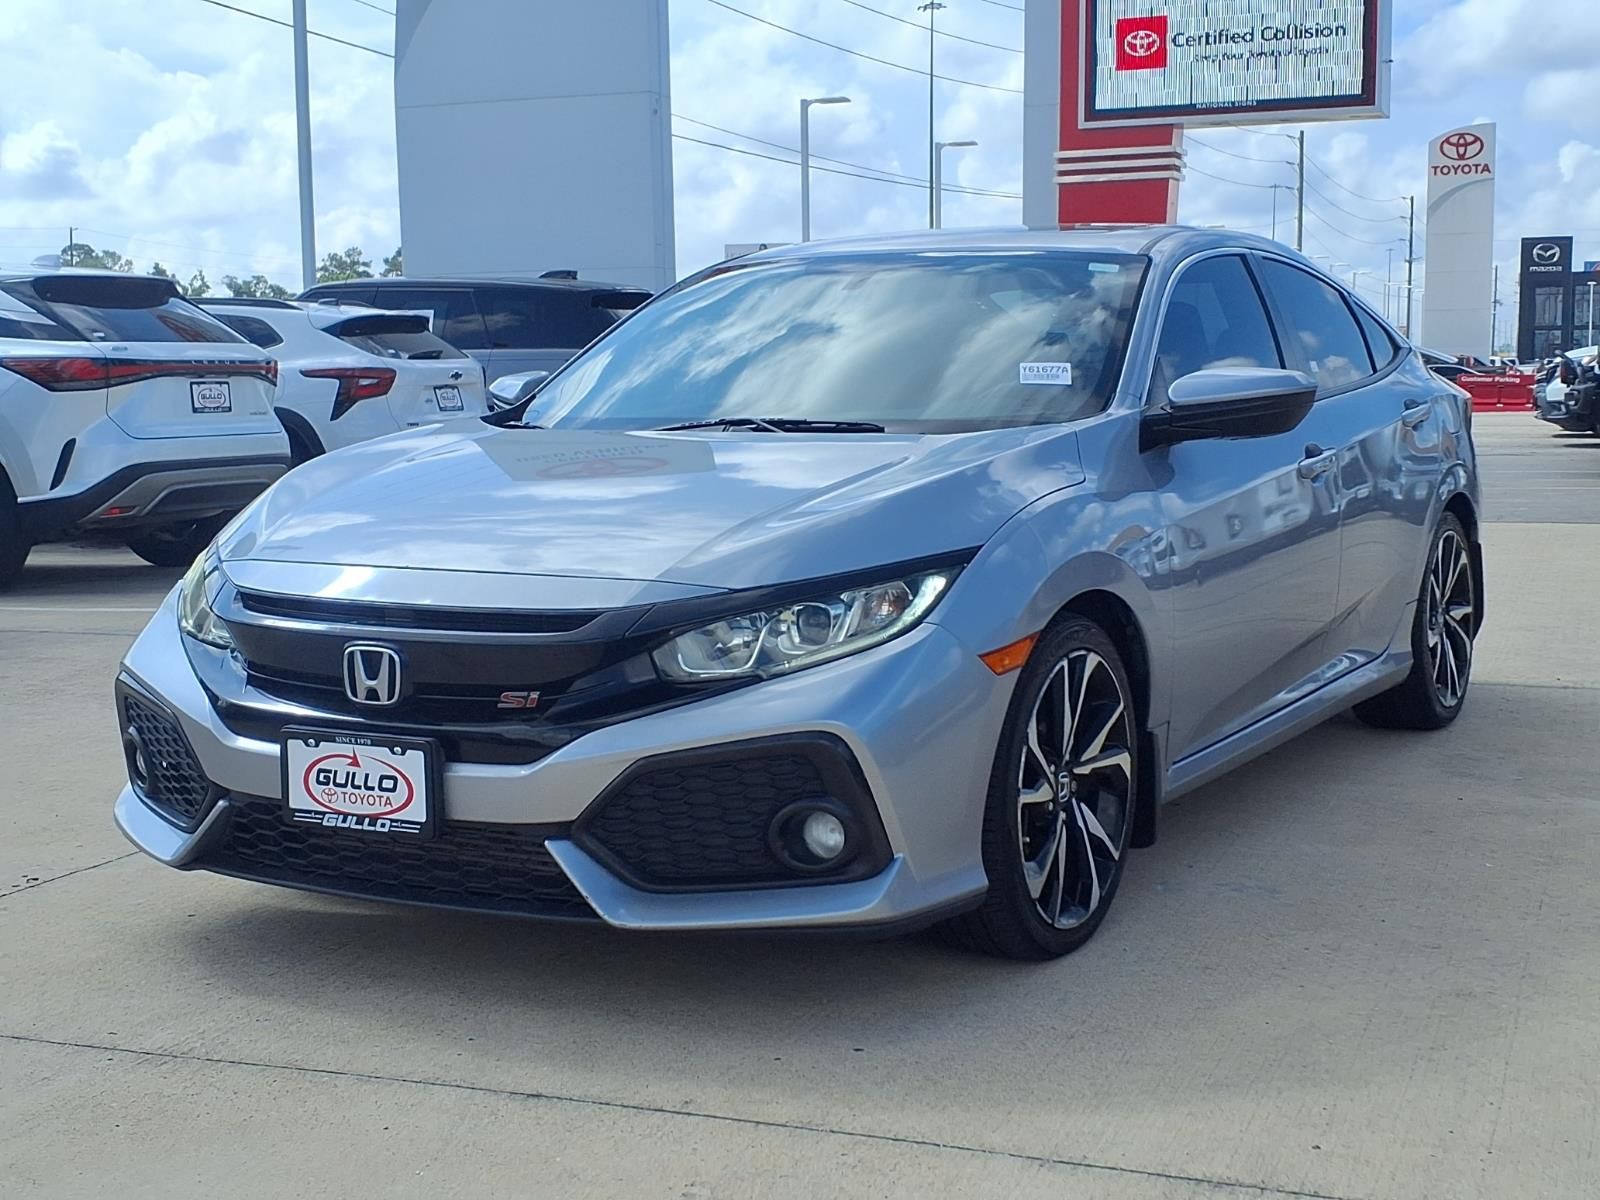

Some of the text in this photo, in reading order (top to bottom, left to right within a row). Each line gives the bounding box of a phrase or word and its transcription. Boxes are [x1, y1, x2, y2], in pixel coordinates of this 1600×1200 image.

[1172, 23, 1347, 47] Certified Collision
[1195, 101, 1233, 109] NATIONAL
[1431, 163, 1492, 177] TOYOTA
[1022, 365, 1069, 374] Y61677A
[1495, 376, 1520, 384] Parking
[497, 691, 541, 708] Si
[335, 736, 357, 744] SINCE
[315, 767, 399, 793] GULLO
[340, 791, 394, 808] TOYOTA
[322, 813, 391, 833] GULLO
